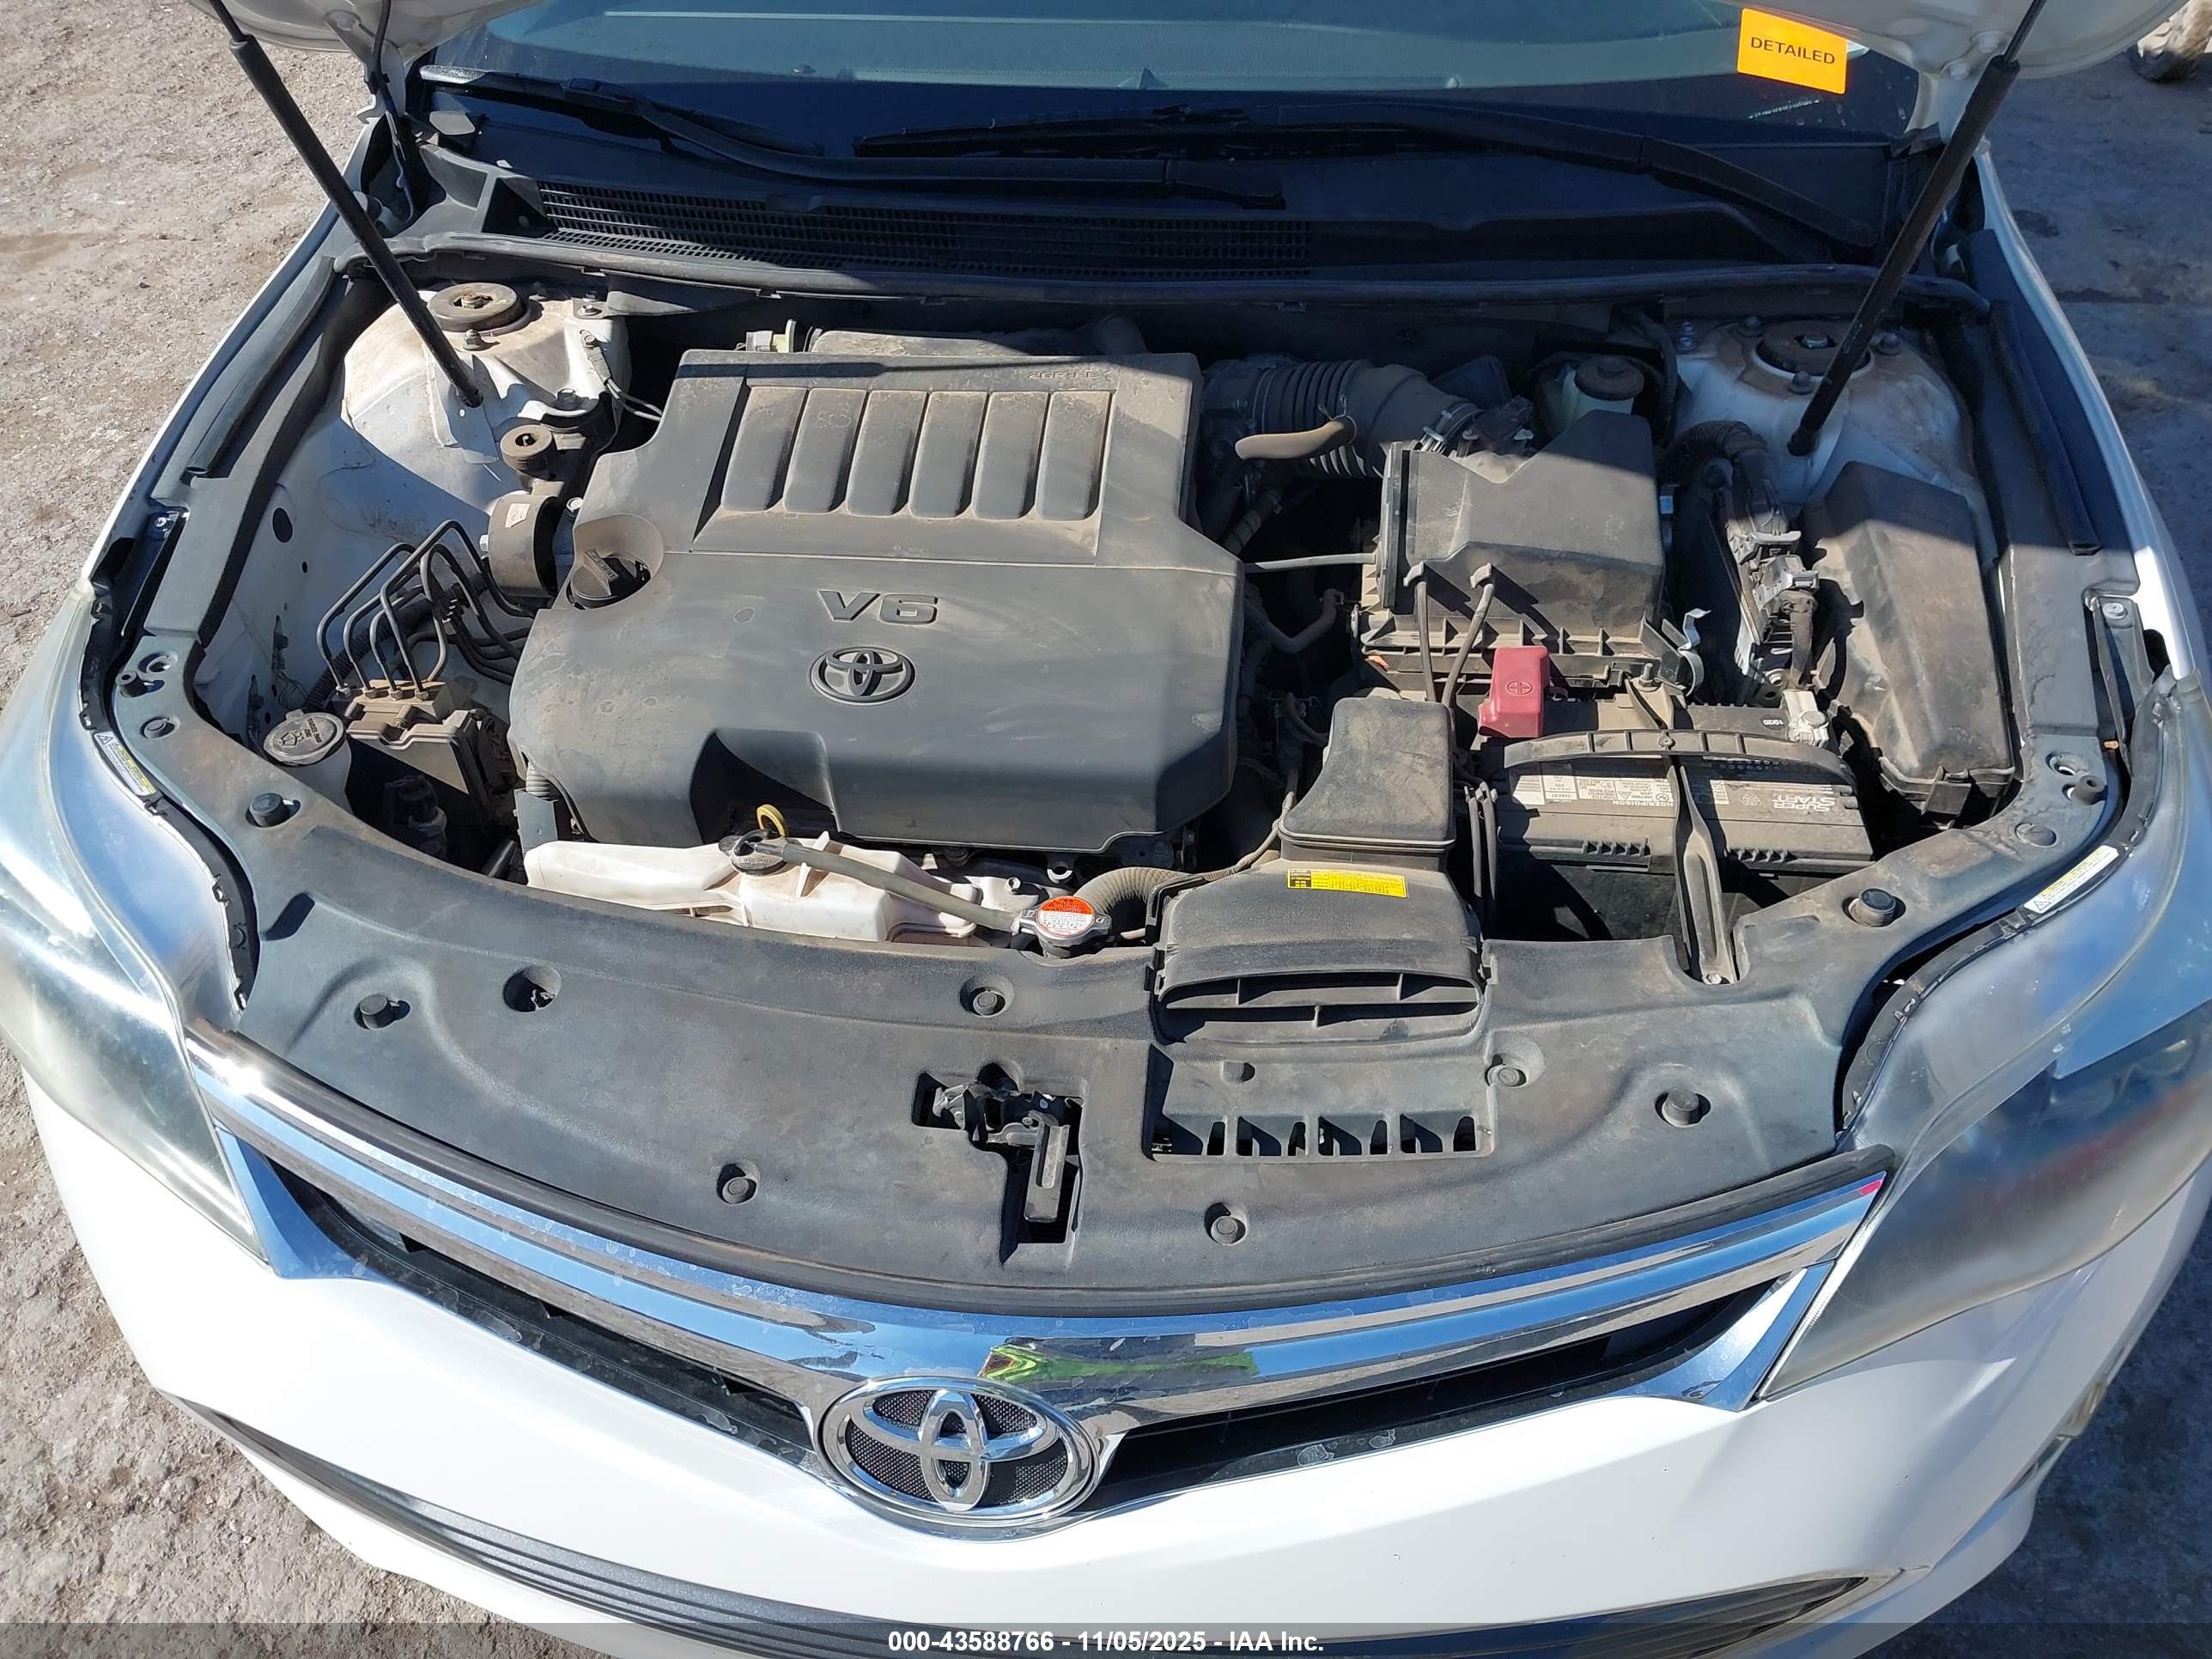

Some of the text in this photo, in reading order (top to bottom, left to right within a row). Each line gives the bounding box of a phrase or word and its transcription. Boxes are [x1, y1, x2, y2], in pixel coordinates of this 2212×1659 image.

[1751, 37, 1835, 64] DETAILED
[817, 589, 940, 625] V6
[1771, 795, 1836, 807] START
[1773, 802, 1830, 811] SUPER
